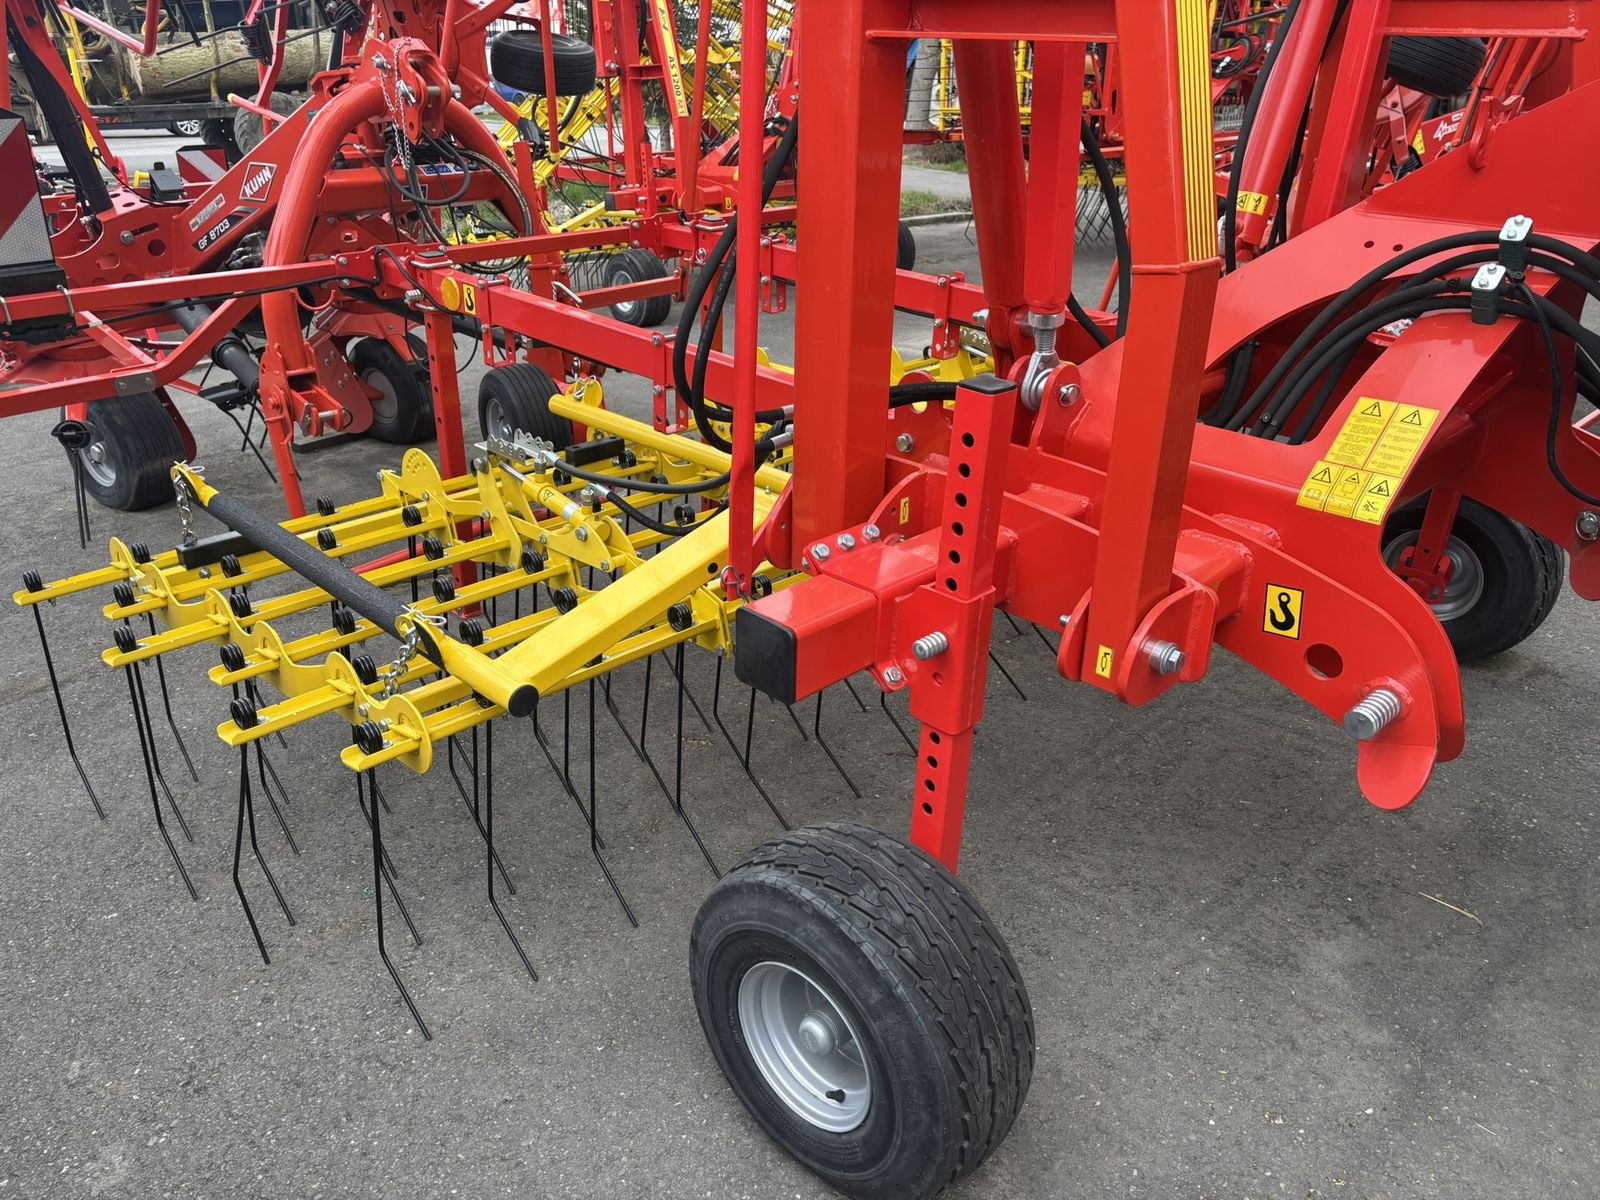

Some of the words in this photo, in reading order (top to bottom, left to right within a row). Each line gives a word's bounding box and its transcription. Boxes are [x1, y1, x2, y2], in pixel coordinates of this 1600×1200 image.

[668, 56, 677, 69] AS
[672, 72, 682, 96] 1200
[244, 166, 273, 198] KUHN
[198, 235, 208, 249] GF
[209, 218, 231, 240] 8703
